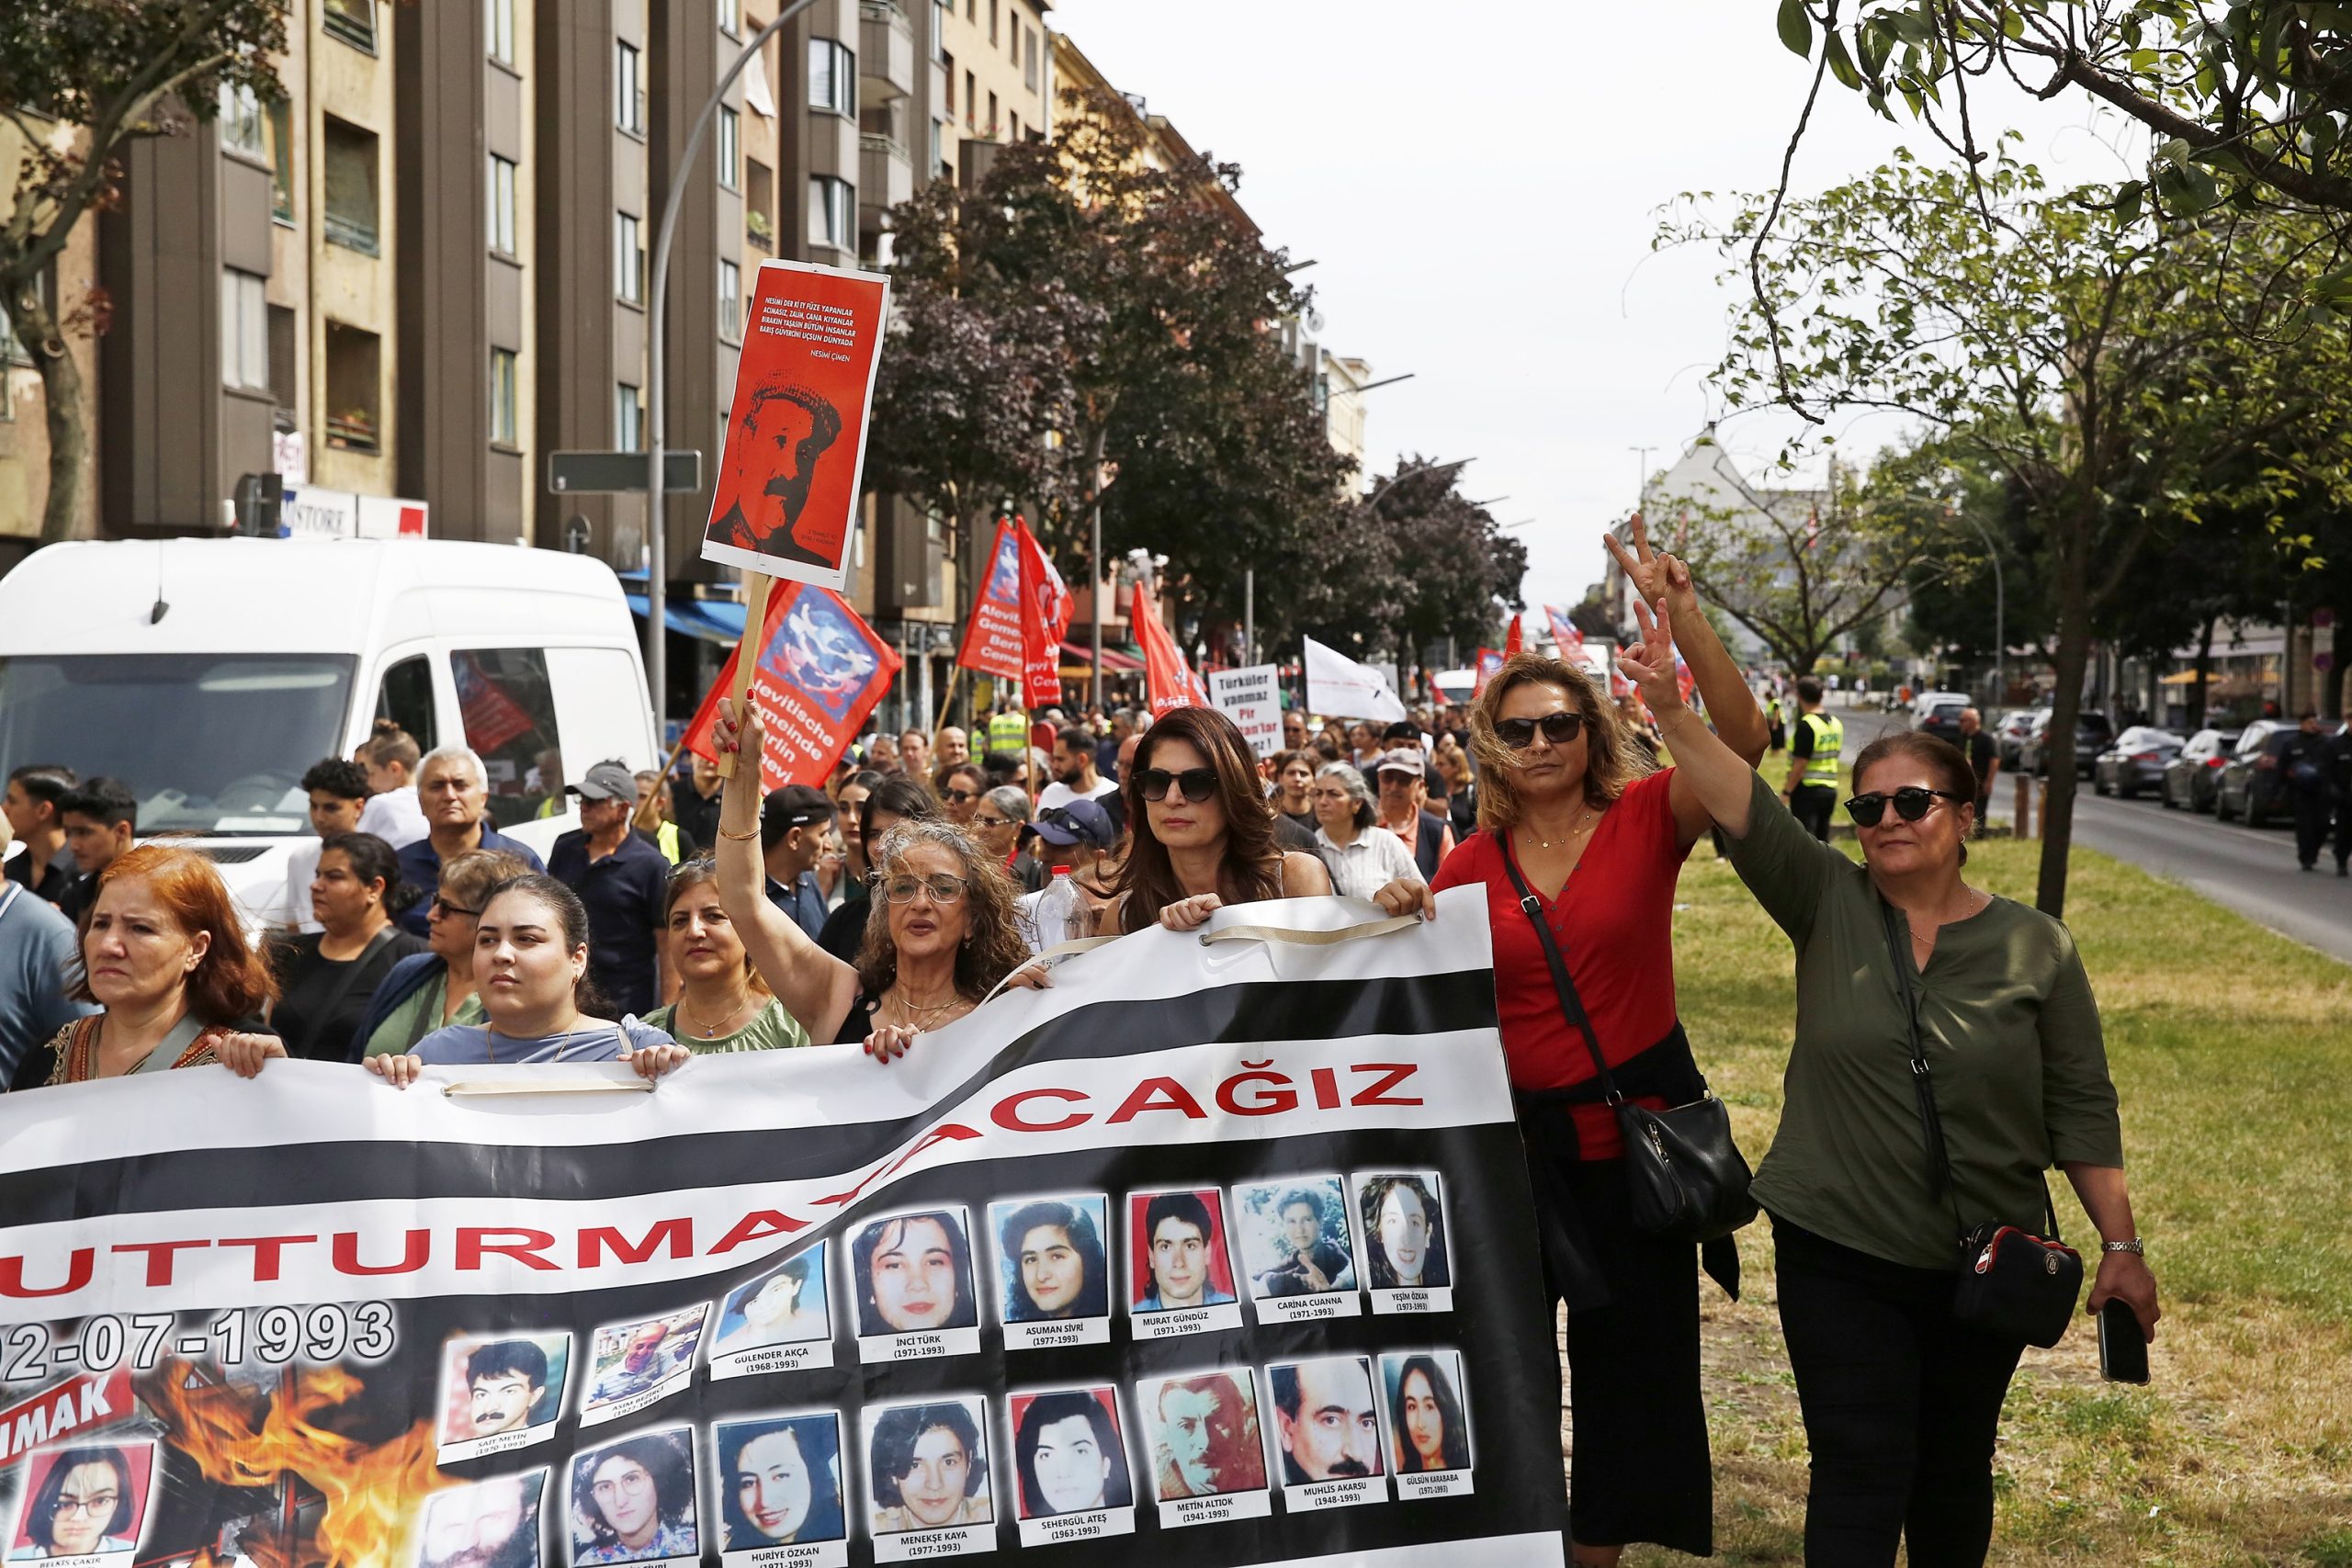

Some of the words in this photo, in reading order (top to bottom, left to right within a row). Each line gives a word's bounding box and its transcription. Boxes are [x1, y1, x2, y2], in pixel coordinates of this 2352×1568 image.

[784, 299, 794, 308] DER
[806, 301, 820, 311] FÜZE
[821, 305, 853, 316] YAPANLAR
[762, 316, 783, 325] BIRAKIN
[804, 321, 823, 332] BÜTÜN
[825, 324, 856, 337] İNSANLAR
[806, 313, 822, 321] CANA
[823, 316, 854, 326] KIYANLAR
[760, 325, 775, 336] BARIŞ
[802, 333, 822, 342] UÇSUN
[823, 334, 854, 346] DÜNYADA
[810, 349, 831, 359] NESİMİ
[831, 351, 850, 362] ÇİMEN
[1219, 674, 1268, 690] Türküler
[1224, 691, 1267, 707] yanmaz
[754, 679, 834, 748] levitische
[1238, 708, 1255, 719] Pir
[761, 707, 822, 761] meinde
[1277, 1299, 1307, 1309] CARİNA
[1309, 1297, 1342, 1306] CUANNA
[1392, 1292, 1410, 1302] YEŞİM
[1411, 1292, 1429, 1301] ÖZKAN
[1290, 1308, 1334, 1320] (1971-1993)
[1396, 1303, 1427, 1312] (1973-1993)
[1143, 1316, 1170, 1325] MURAT
[1173, 1312, 1209, 1323] GÜNDÜZ
[1025, 1325, 1062, 1335] ASUMAN
[1064, 1322, 1083, 1332] SİVRİ
[1154, 1323, 1201, 1337] (1971-1993)
[0, 1301, 395, 1381] 2-07-1993
[897, 1337, 915, 1347] İNCİ
[917, 1335, 941, 1345] TÜRK
[1033, 1335, 1079, 1347] (1977-1993)
[735, 1351, 782, 1364] GÜLENDER
[785, 1348, 808, 1357] AKÇA
[894, 1346, 944, 1359] (1971-1993)
[746, 1359, 798, 1373] (1968-1993)
[1407, 1475, 1430, 1484] GÜLSÜN
[1430, 1473, 1459, 1483] KARABABA
[1304, 1483, 1335, 1496] MUHLİS
[1337, 1482, 1367, 1492] AKARSU
[1419, 1485, 1448, 1495] (1971-1993)
[1177, 1500, 1204, 1512] METİN
[1205, 1498, 1233, 1508] ALTIOK
[1315, 1494, 1361, 1506] (1948-1993)
[1042, 1516, 1085, 1529] SEHERGÜL
[1087, 1514, 1107, 1524] ATEŞ
[1183, 1509, 1229, 1523] (1941-1993)
[900, 1533, 942, 1545] MENEKŞE
[944, 1531, 967, 1540] KAYA
[1052, 1526, 1101, 1540] (1963-1993)
[752, 1550, 785, 1562] HURİYE
[786, 1547, 820, 1558] ÖZKAN
[909, 1543, 961, 1556] (1977-1993)
